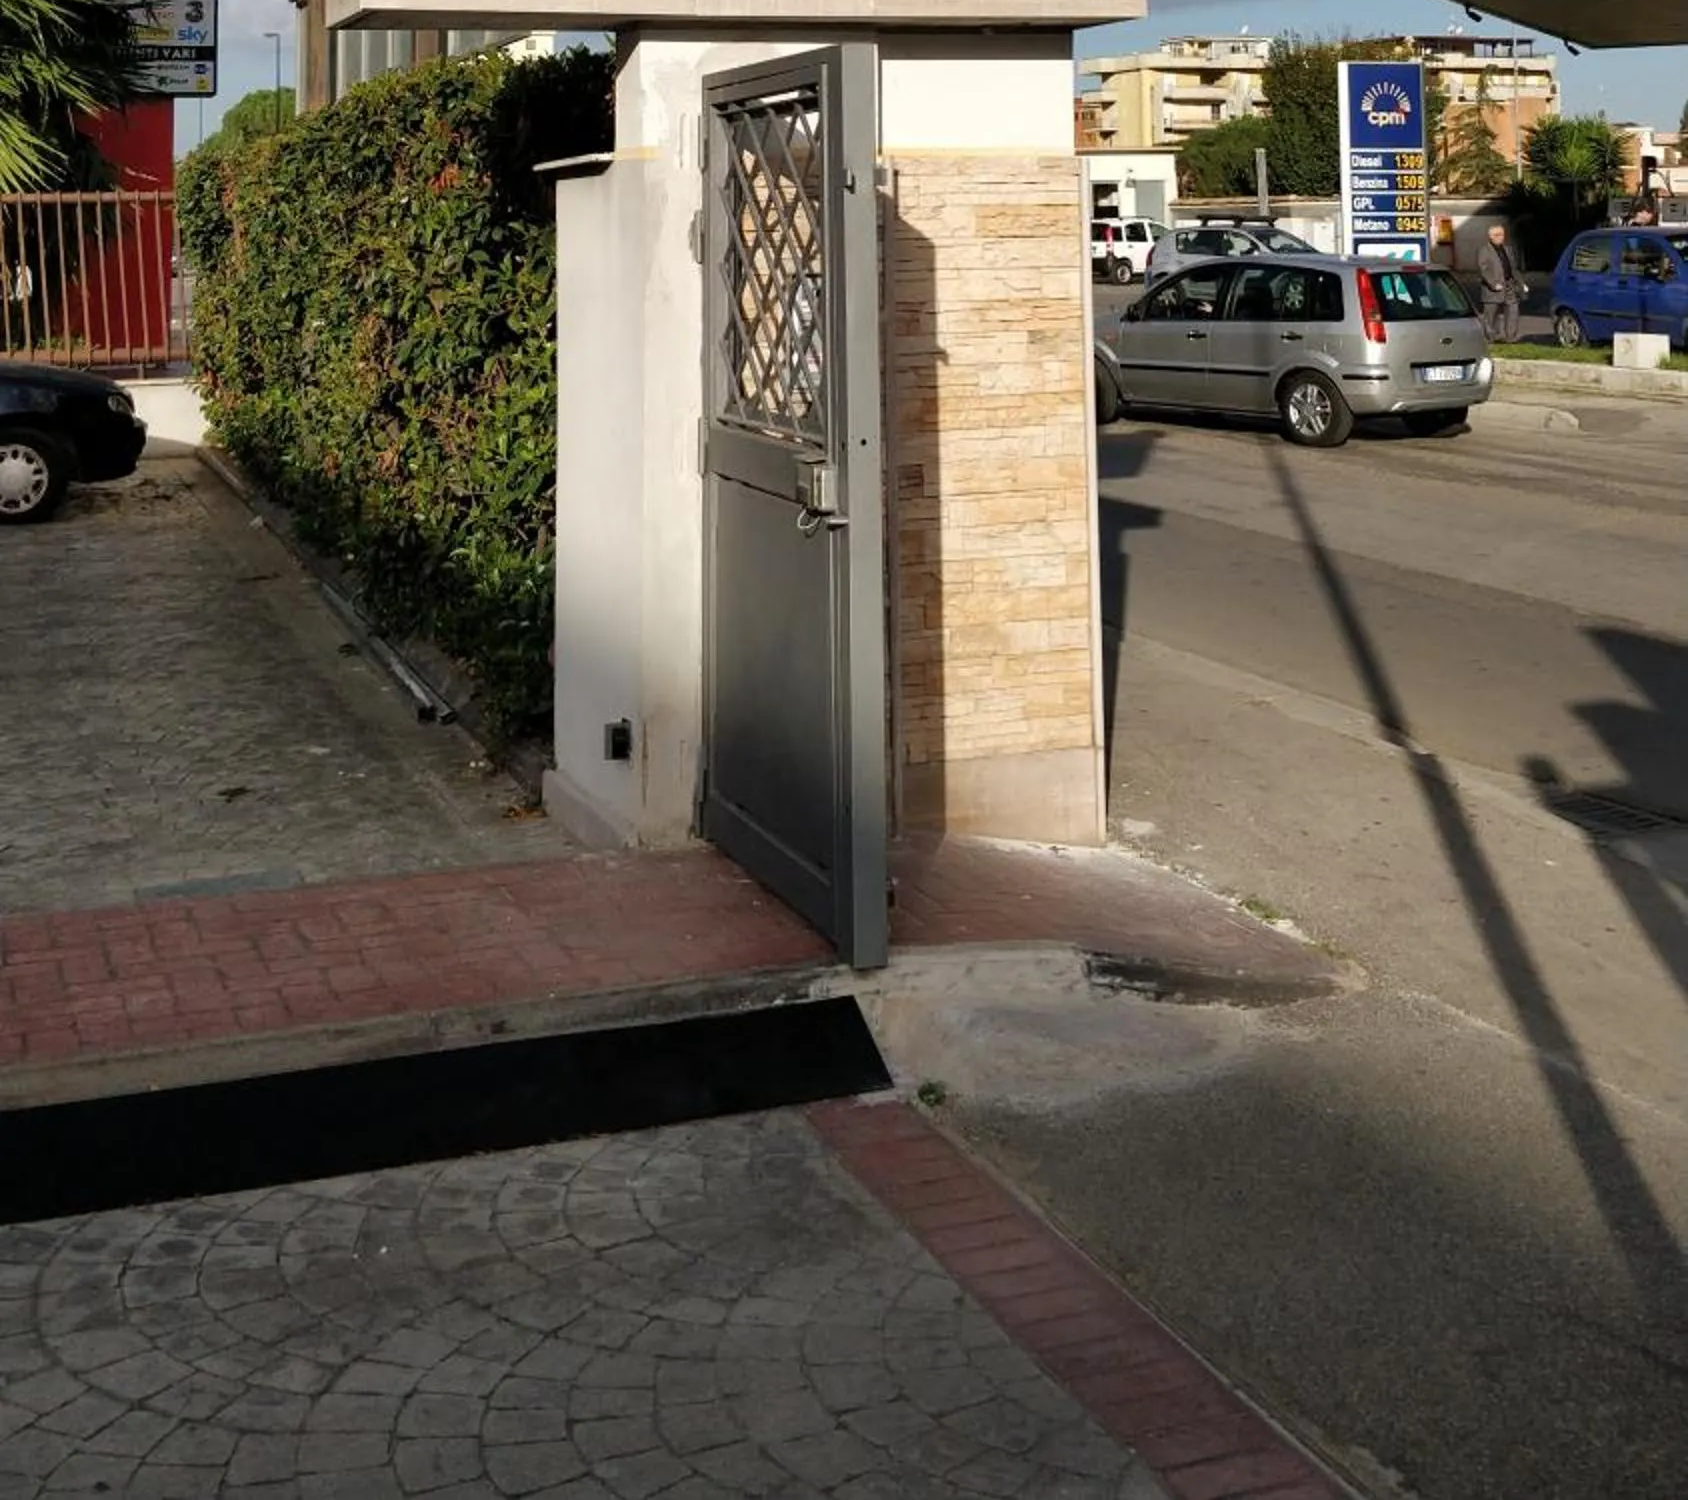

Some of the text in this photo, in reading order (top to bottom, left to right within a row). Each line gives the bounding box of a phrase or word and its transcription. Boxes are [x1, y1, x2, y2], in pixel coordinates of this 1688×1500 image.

[177, 25, 208, 44] sky
[1368, 109, 1406, 127] cpm
[1351, 155, 1383, 167] Diesel
[1352, 176, 1389, 189] Benzina
[1353, 196, 1376, 210] GPL
[1354, 218, 1390, 231] Metano
